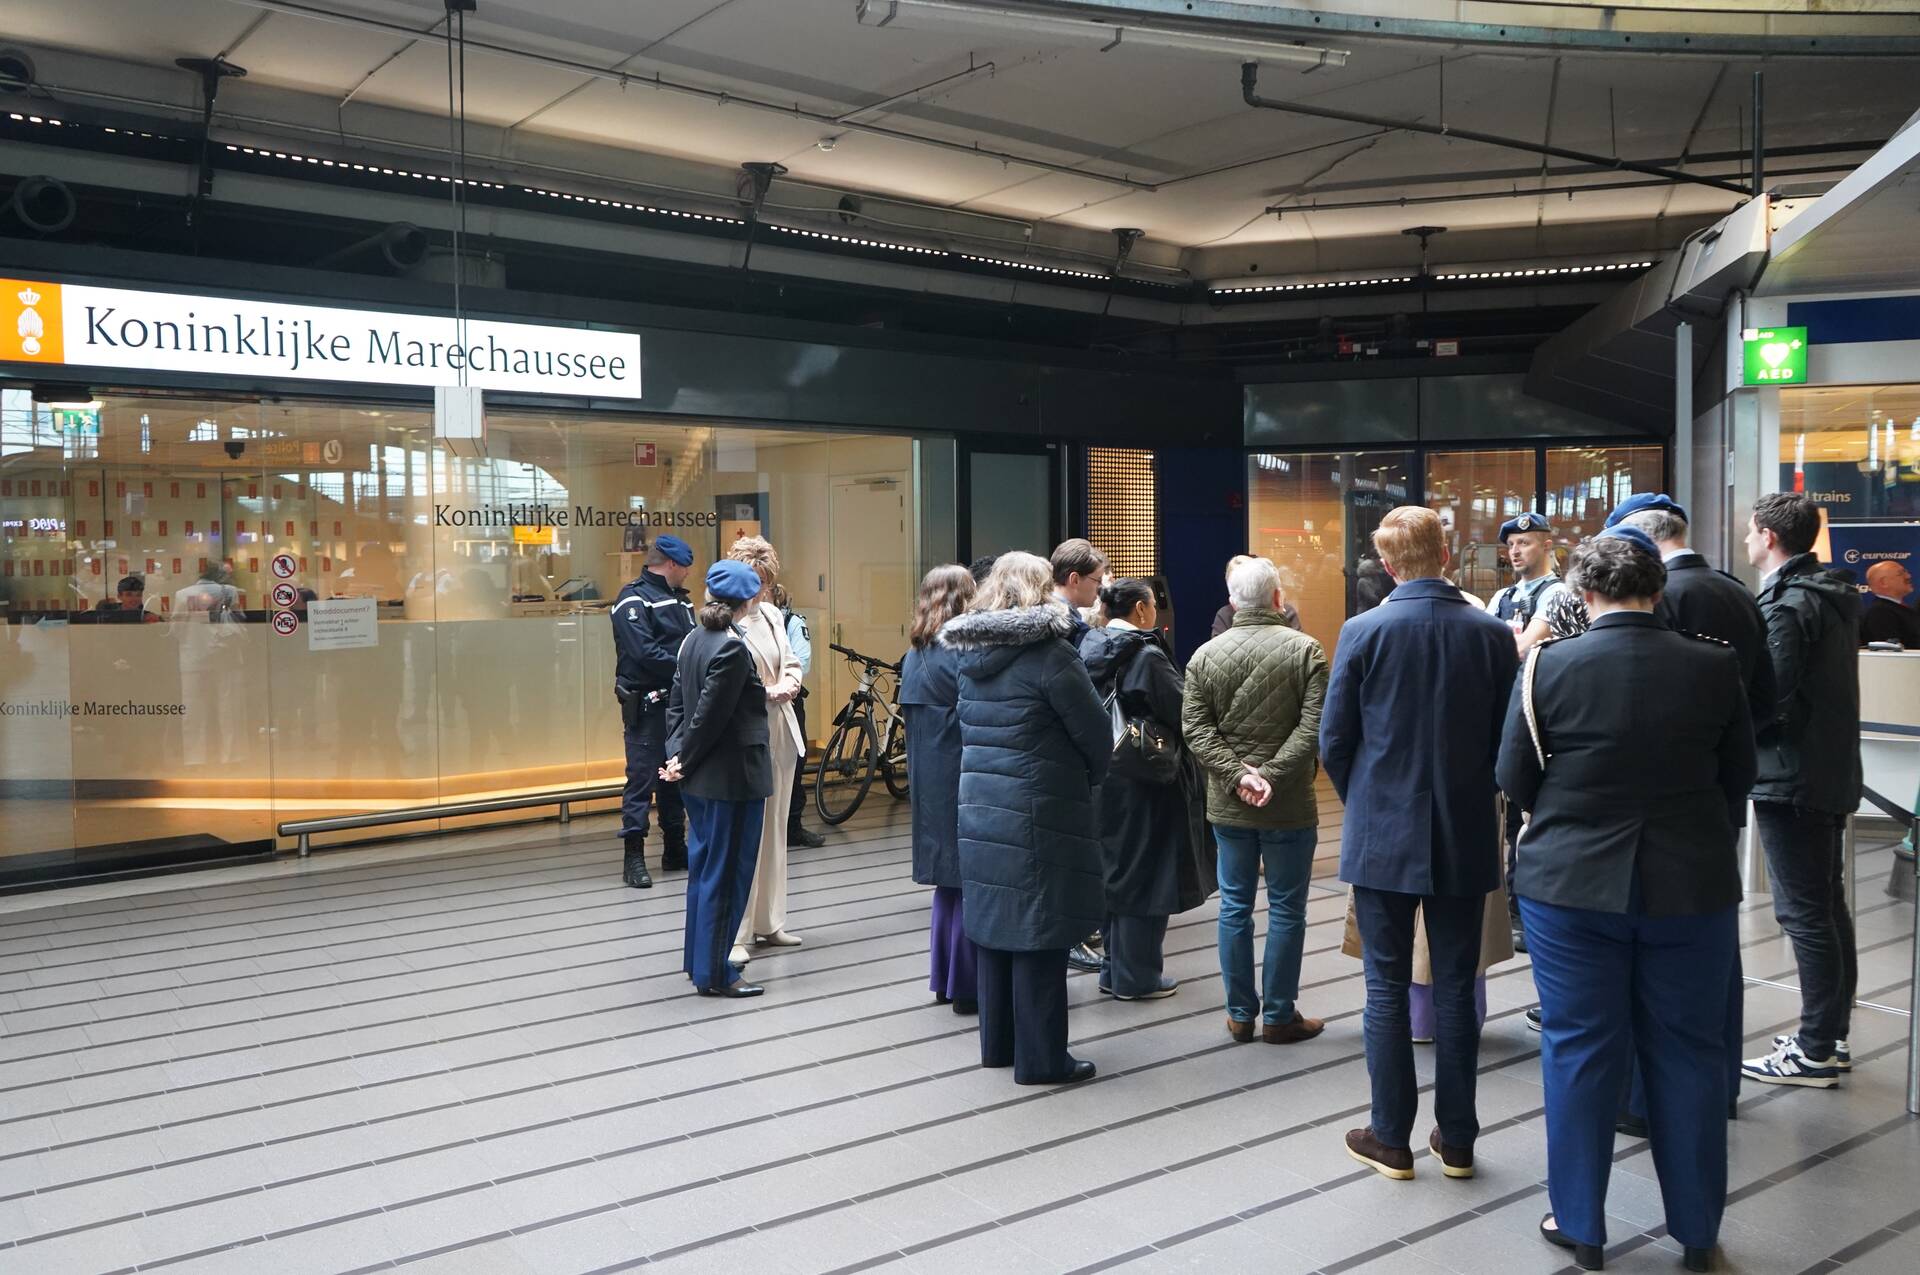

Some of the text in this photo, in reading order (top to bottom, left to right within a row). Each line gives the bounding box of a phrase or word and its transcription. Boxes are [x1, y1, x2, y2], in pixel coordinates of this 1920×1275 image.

[85, 306, 627, 381] Koninklijke Marechaussee
[1757, 368, 1793, 379] AED
[1812, 490, 1851, 502] trains
[434, 504, 717, 533] Koninklijke Marechaussee
[1861, 551, 1911, 560] eurostar
[83, 700, 186, 716] Marechaussee
